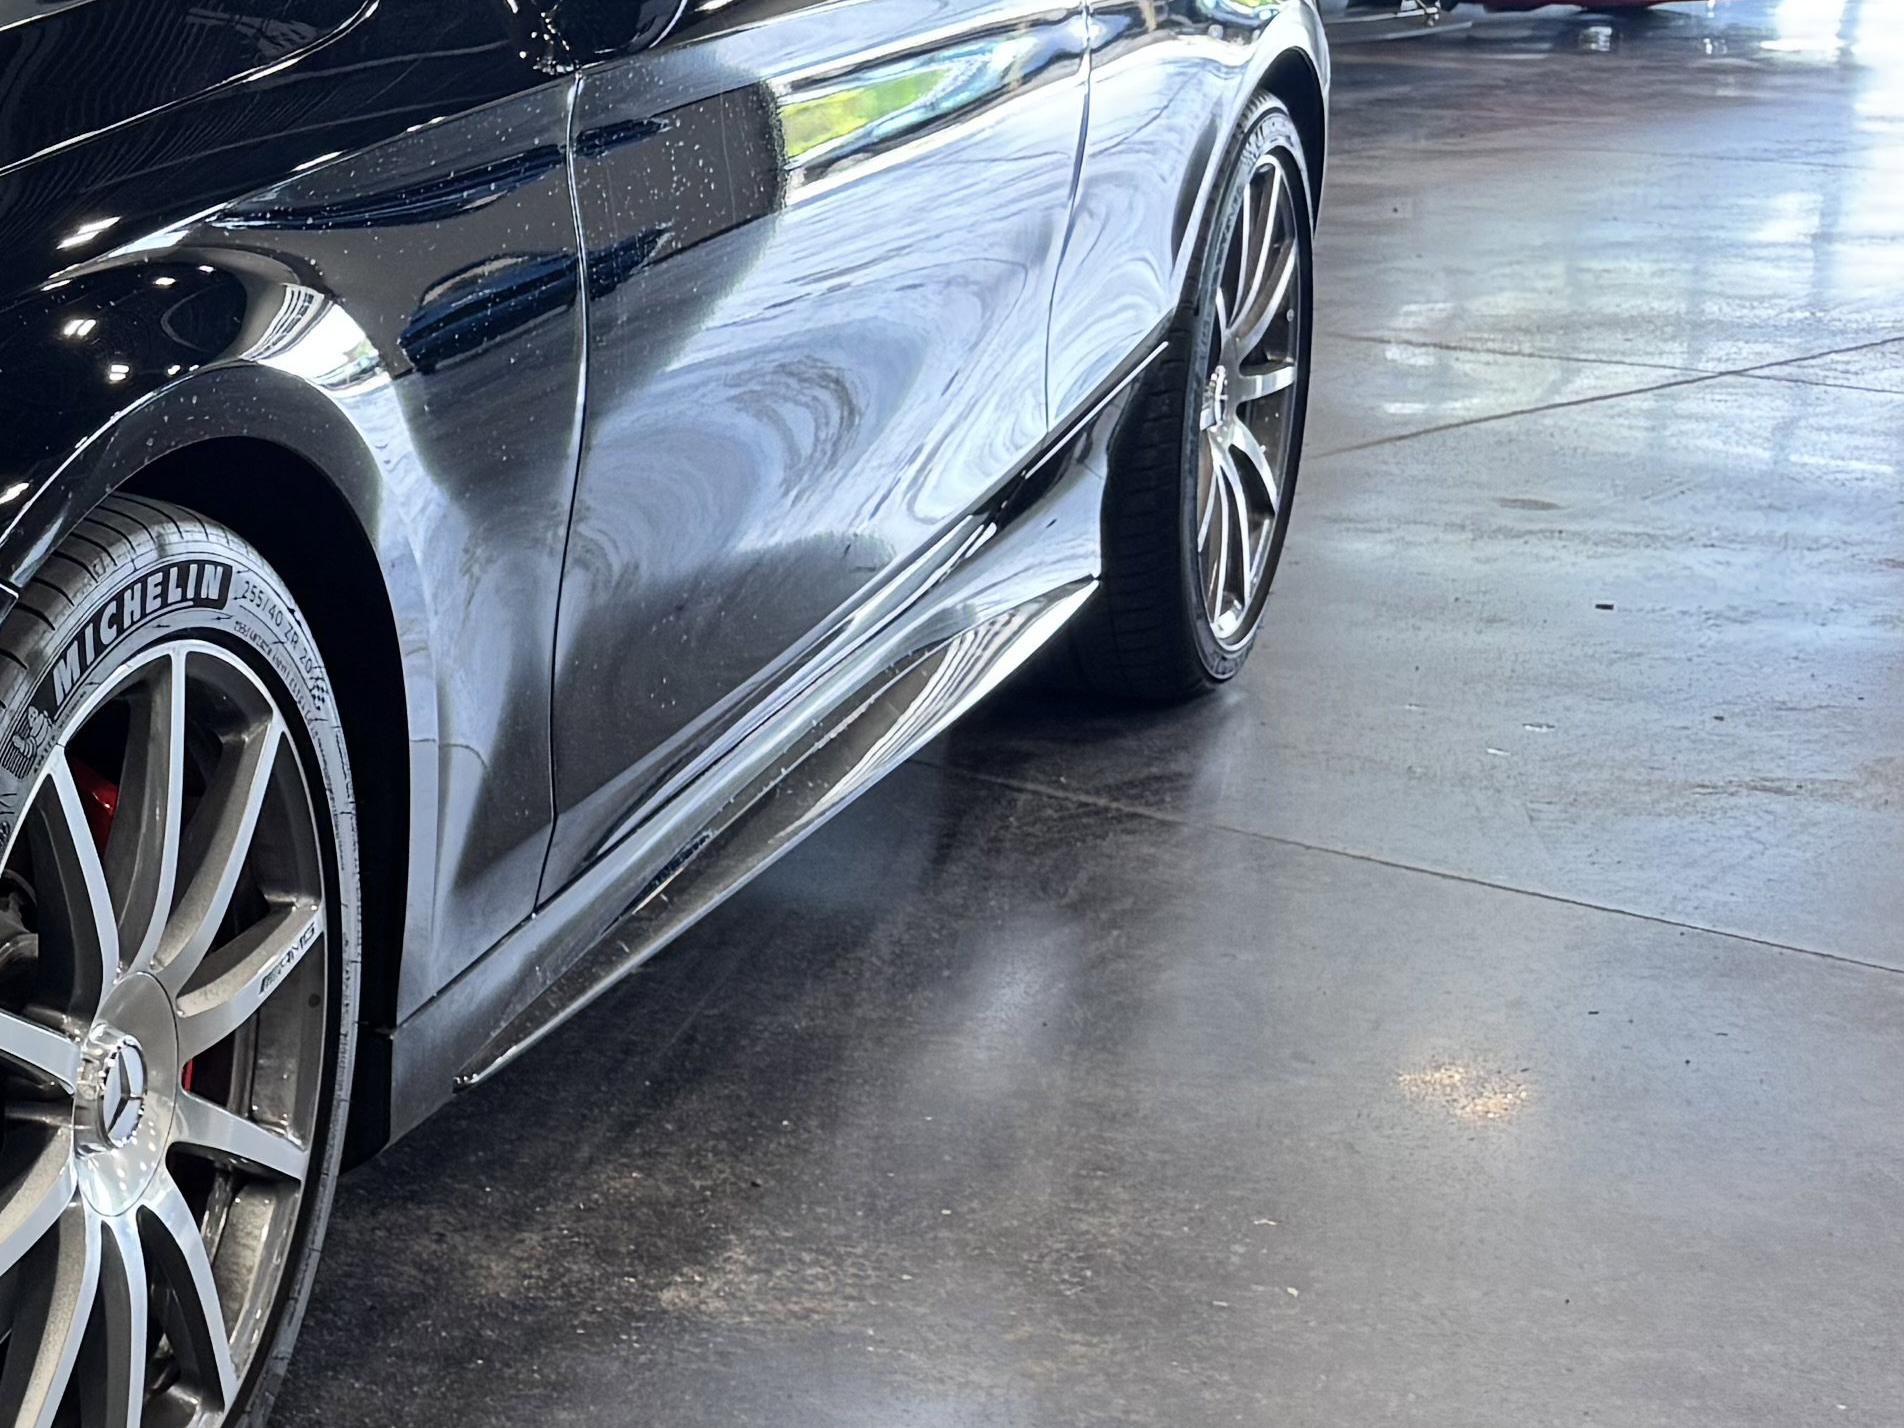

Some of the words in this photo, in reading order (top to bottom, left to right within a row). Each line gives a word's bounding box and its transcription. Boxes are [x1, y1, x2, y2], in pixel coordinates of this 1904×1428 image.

[52, 563, 224, 707] MICHELIN
[242, 580, 284, 628] 255/40
[298, 646, 313, 675] 20
